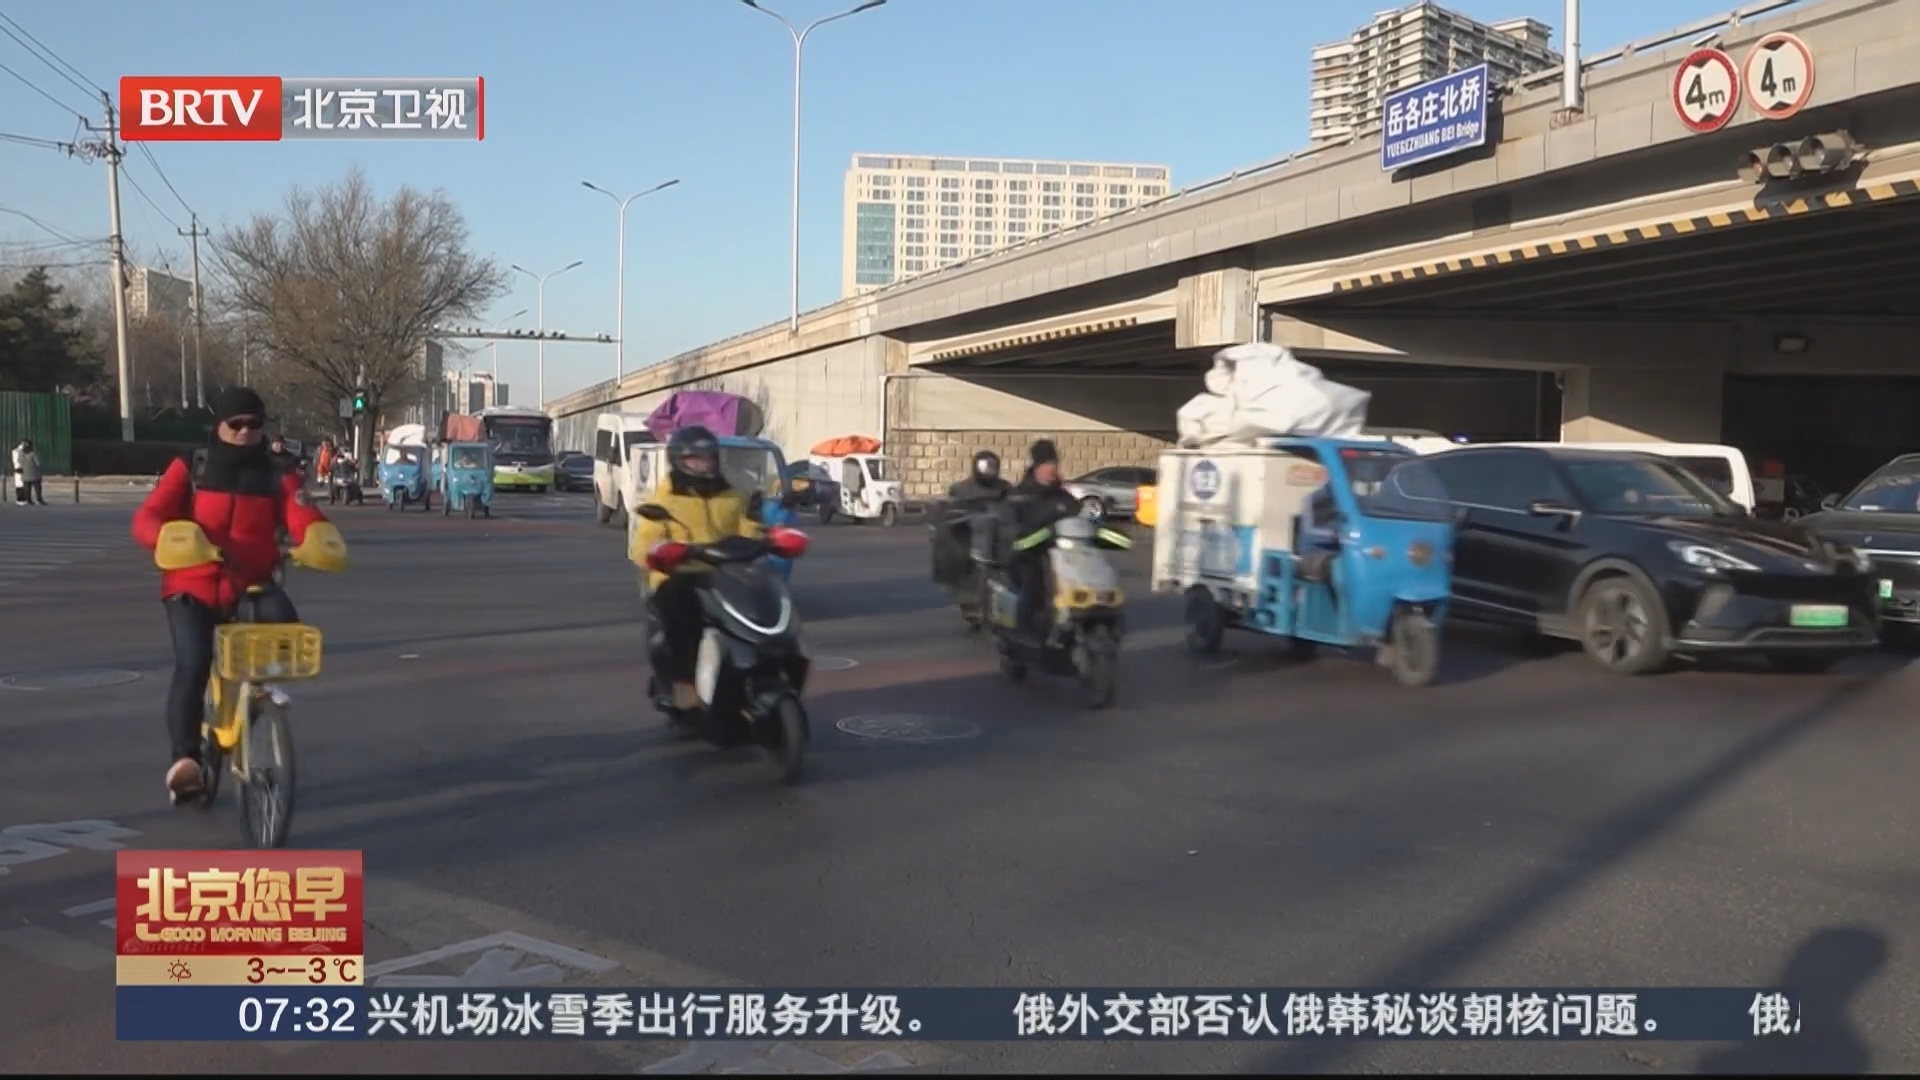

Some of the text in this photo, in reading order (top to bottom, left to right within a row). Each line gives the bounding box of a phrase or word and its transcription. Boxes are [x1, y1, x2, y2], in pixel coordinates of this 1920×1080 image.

[1387, 75, 1480, 137] 岳各庄北桥
[1386, 120, 1479, 158] YUEGEZHUANG BEI Bridge
